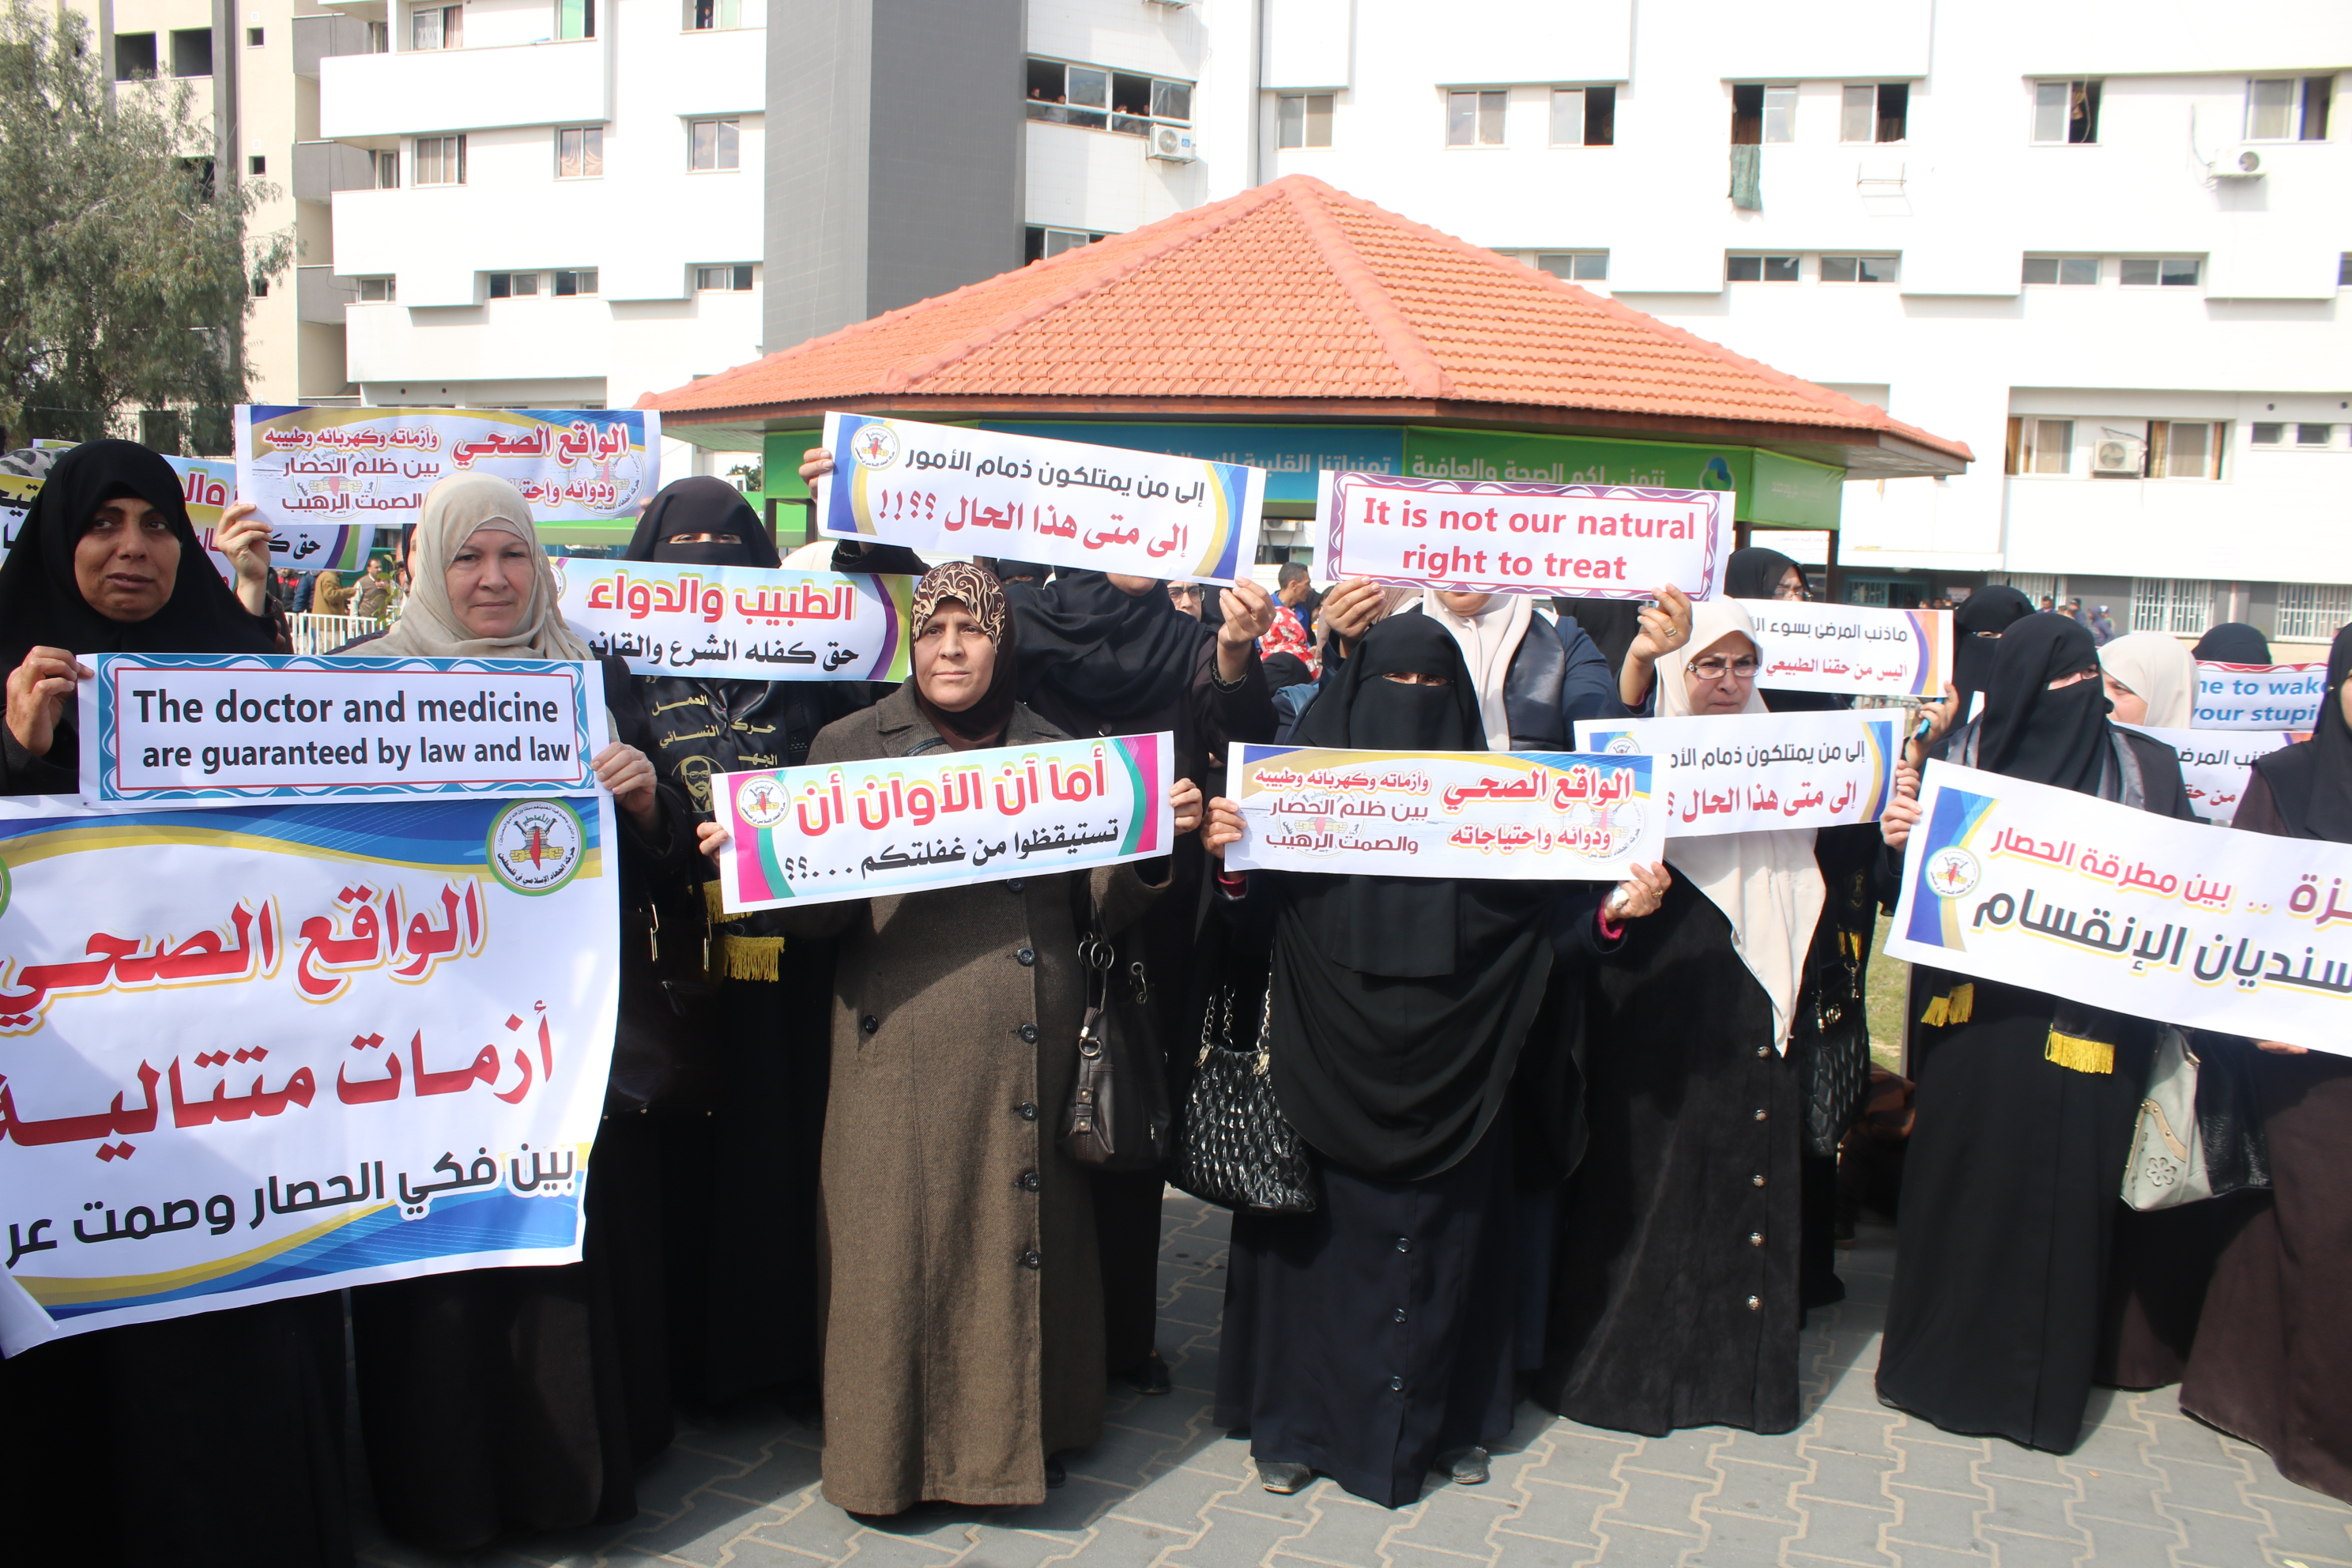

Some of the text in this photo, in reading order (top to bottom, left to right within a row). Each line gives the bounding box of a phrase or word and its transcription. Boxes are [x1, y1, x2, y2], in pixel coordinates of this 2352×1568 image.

[266, 430, 438, 447] وأزماته وكهربائه وطبيبه
[454, 423, 627, 466] الواقع الصحي
[285, 458, 439, 479] بين ظلم الحصار
[906, 450, 971, 471] الأمور
[976, 456, 1031, 478] ذمام
[1412, 454, 1498, 480] والعافية
[1504, 460, 1563, 483] الصحة
[1570, 466, 1605, 485] لكم
[565, 480, 614, 503] ودوائه
[1038, 462, 1131, 496] يمتلكون
[1137, 475, 1169, 499] من
[1175, 482, 1204, 507] إلى
[283, 494, 423, 512] الصمت الرهيب
[945, 497, 1023, 531] الحال
[1364, 498, 1694, 539] It is not our natural
[1035, 506, 1077, 538] هذا
[1084, 514, 1139, 549] متى
[1148, 524, 1187, 557] إلى
[1403, 545, 1626, 580] right to treat
[589, 576, 723, 623] والدواء
[736, 586, 853, 626] الطبيب
[1770, 623, 1810, 636] بسوء
[588, 631, 859, 671] حق كفله الشرع والقانو
[1766, 658, 1907, 681] أليس من حقنا الطبيعي
[2233, 679, 2260, 695] to
[133, 689, 557, 722] The doctor and medicine
[652, 695, 708, 716] العمل
[2251, 704, 2317, 725] stupi
[659, 724, 719, 748] النسائي
[730, 718, 776, 734] حرك
[143, 737, 570, 774] are guaranteed by law and law
[1671, 741, 1864, 770] إلى من يمتلكون ذمام الأم
[2178, 748, 2230, 767] المرض
[797, 746, 1105, 836] أما آن الأوان أن
[1256, 771, 1428, 791] وأزماته وكهربائه وطبيبه
[1444, 771, 1547, 810] الصحي
[1554, 768, 1630, 809] الواقع
[1747, 782, 1777, 811] هذا
[1830, 780, 1856, 813] إلى
[1271, 798, 1427, 821] بين ظلم الحصار
[1682, 786, 1740, 823] الحال
[1783, 782, 1823, 816] متى
[973, 839, 1006, 866] من
[1015, 819, 1118, 859] تستيقظوا
[1266, 834, 1418, 854] والصمت الرهيب
[1558, 827, 1611, 850] ودوائه
[1990, 827, 2075, 865] الحصار
[861, 837, 966, 879] غفلتكم
[2080, 848, 2177, 893] مطرقة
[2184, 874, 2231, 907] بين
[2288, 873, 2352, 925] زة
[1973, 889, 2187, 970] الإنقسام
[0, 884, 479, 1027] الواقع الصحي
[337, 1001, 552, 1104] أزمات
[6, 1143, 575, 1269] بين فكي الحصار وصمت عر
